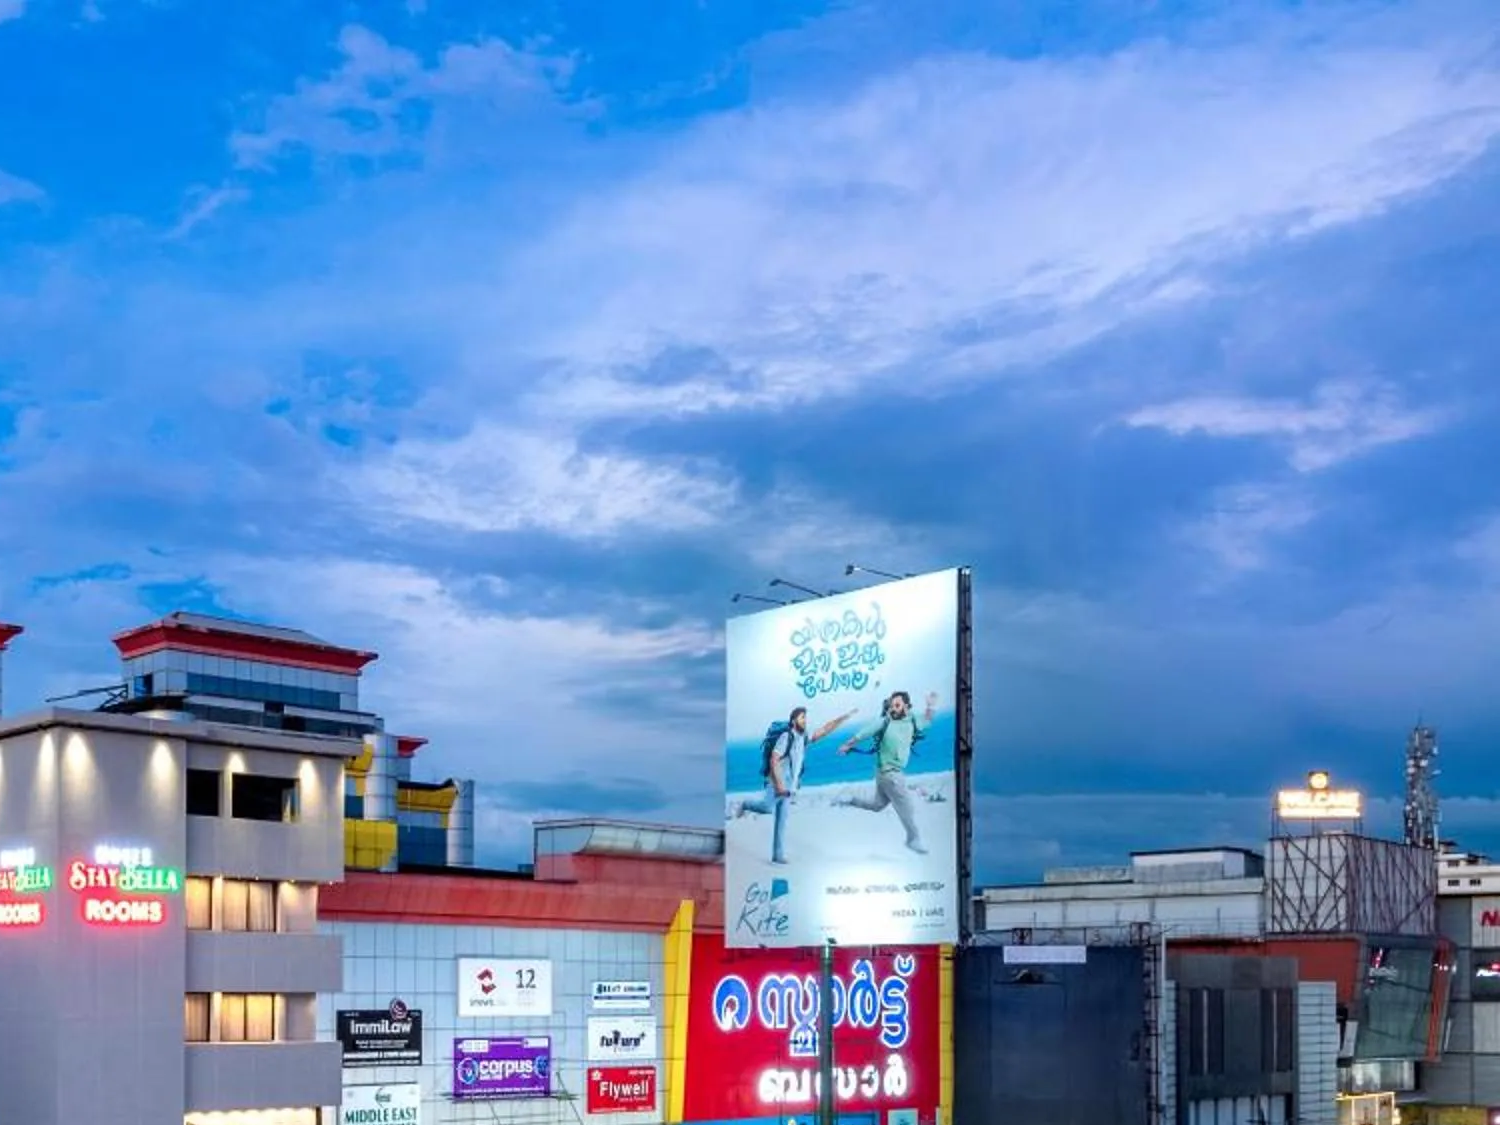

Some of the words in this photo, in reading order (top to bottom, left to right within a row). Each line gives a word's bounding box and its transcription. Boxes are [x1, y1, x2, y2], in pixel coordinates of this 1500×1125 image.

[746, 882, 769, 904] Go
[86, 899, 162, 922] ROOMS
[736, 902, 789, 935] Kite
[516, 968, 537, 989] 12
[479, 1059, 533, 1078] corpus
[599, 1080, 649, 1101] Flywell
[344, 1107, 389, 1124] MIDDLE
[392, 1106, 417, 1121] EAST
